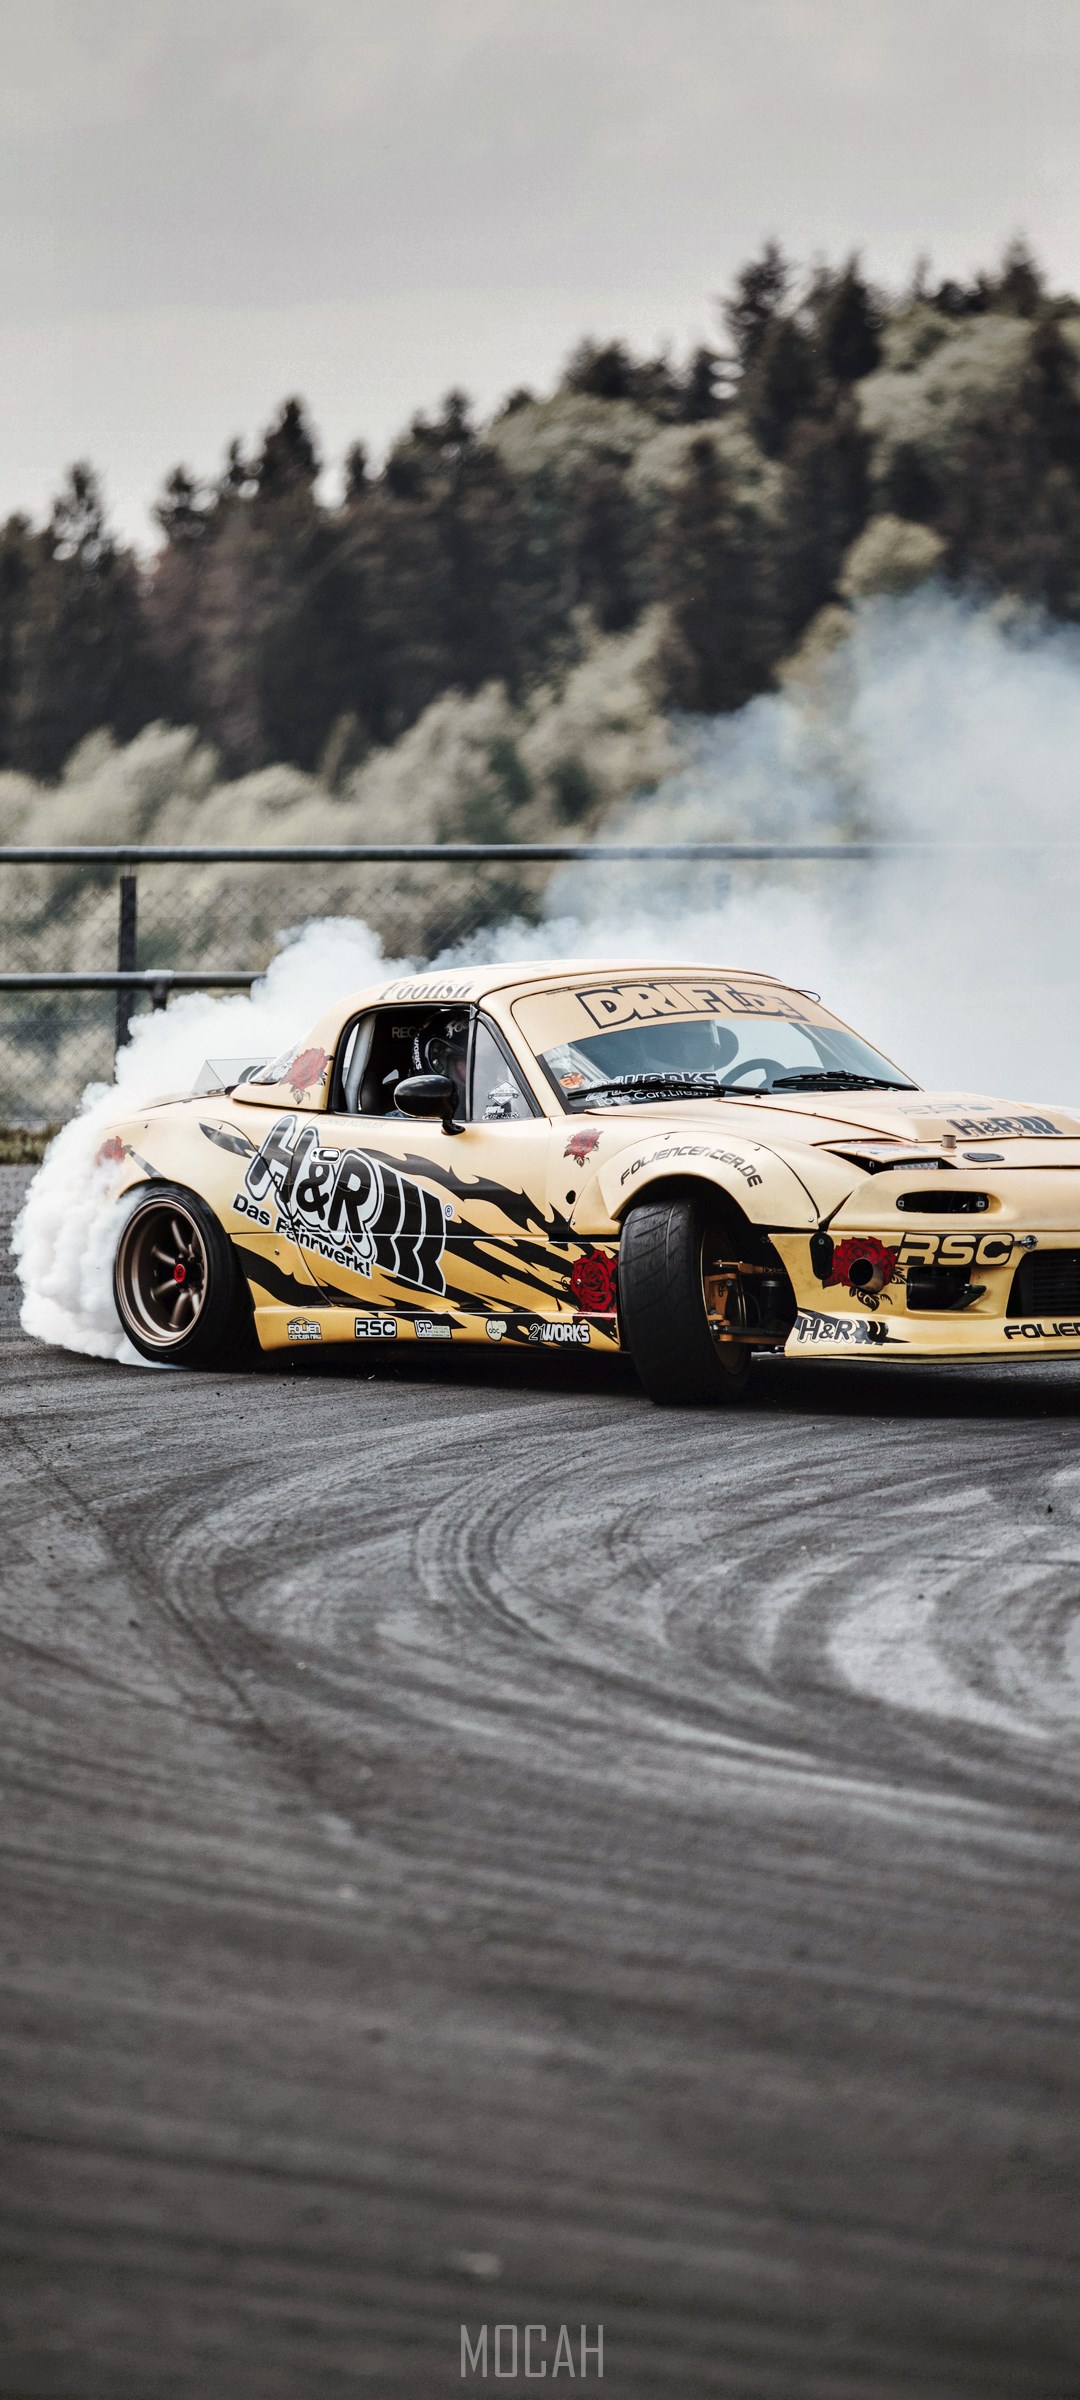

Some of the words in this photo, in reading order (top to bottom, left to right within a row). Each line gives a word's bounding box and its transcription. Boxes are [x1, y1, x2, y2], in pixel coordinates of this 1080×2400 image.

[376, 981, 475, 1001] Foolish
[947, 1117, 1024, 1136] H&R
[246, 1115, 381, 1257] H&R
[233, 1194, 270, 1226] Das
[276, 1216, 371, 1278] Fahrwerk!
[898, 1233, 1014, 1265] RSC
[288, 1324, 320, 1334] FOLIEN
[356, 1320, 396, 1336] RSC
[529, 1322, 590, 1343] 21WORKS
[798, 1319, 857, 1343] H&R
